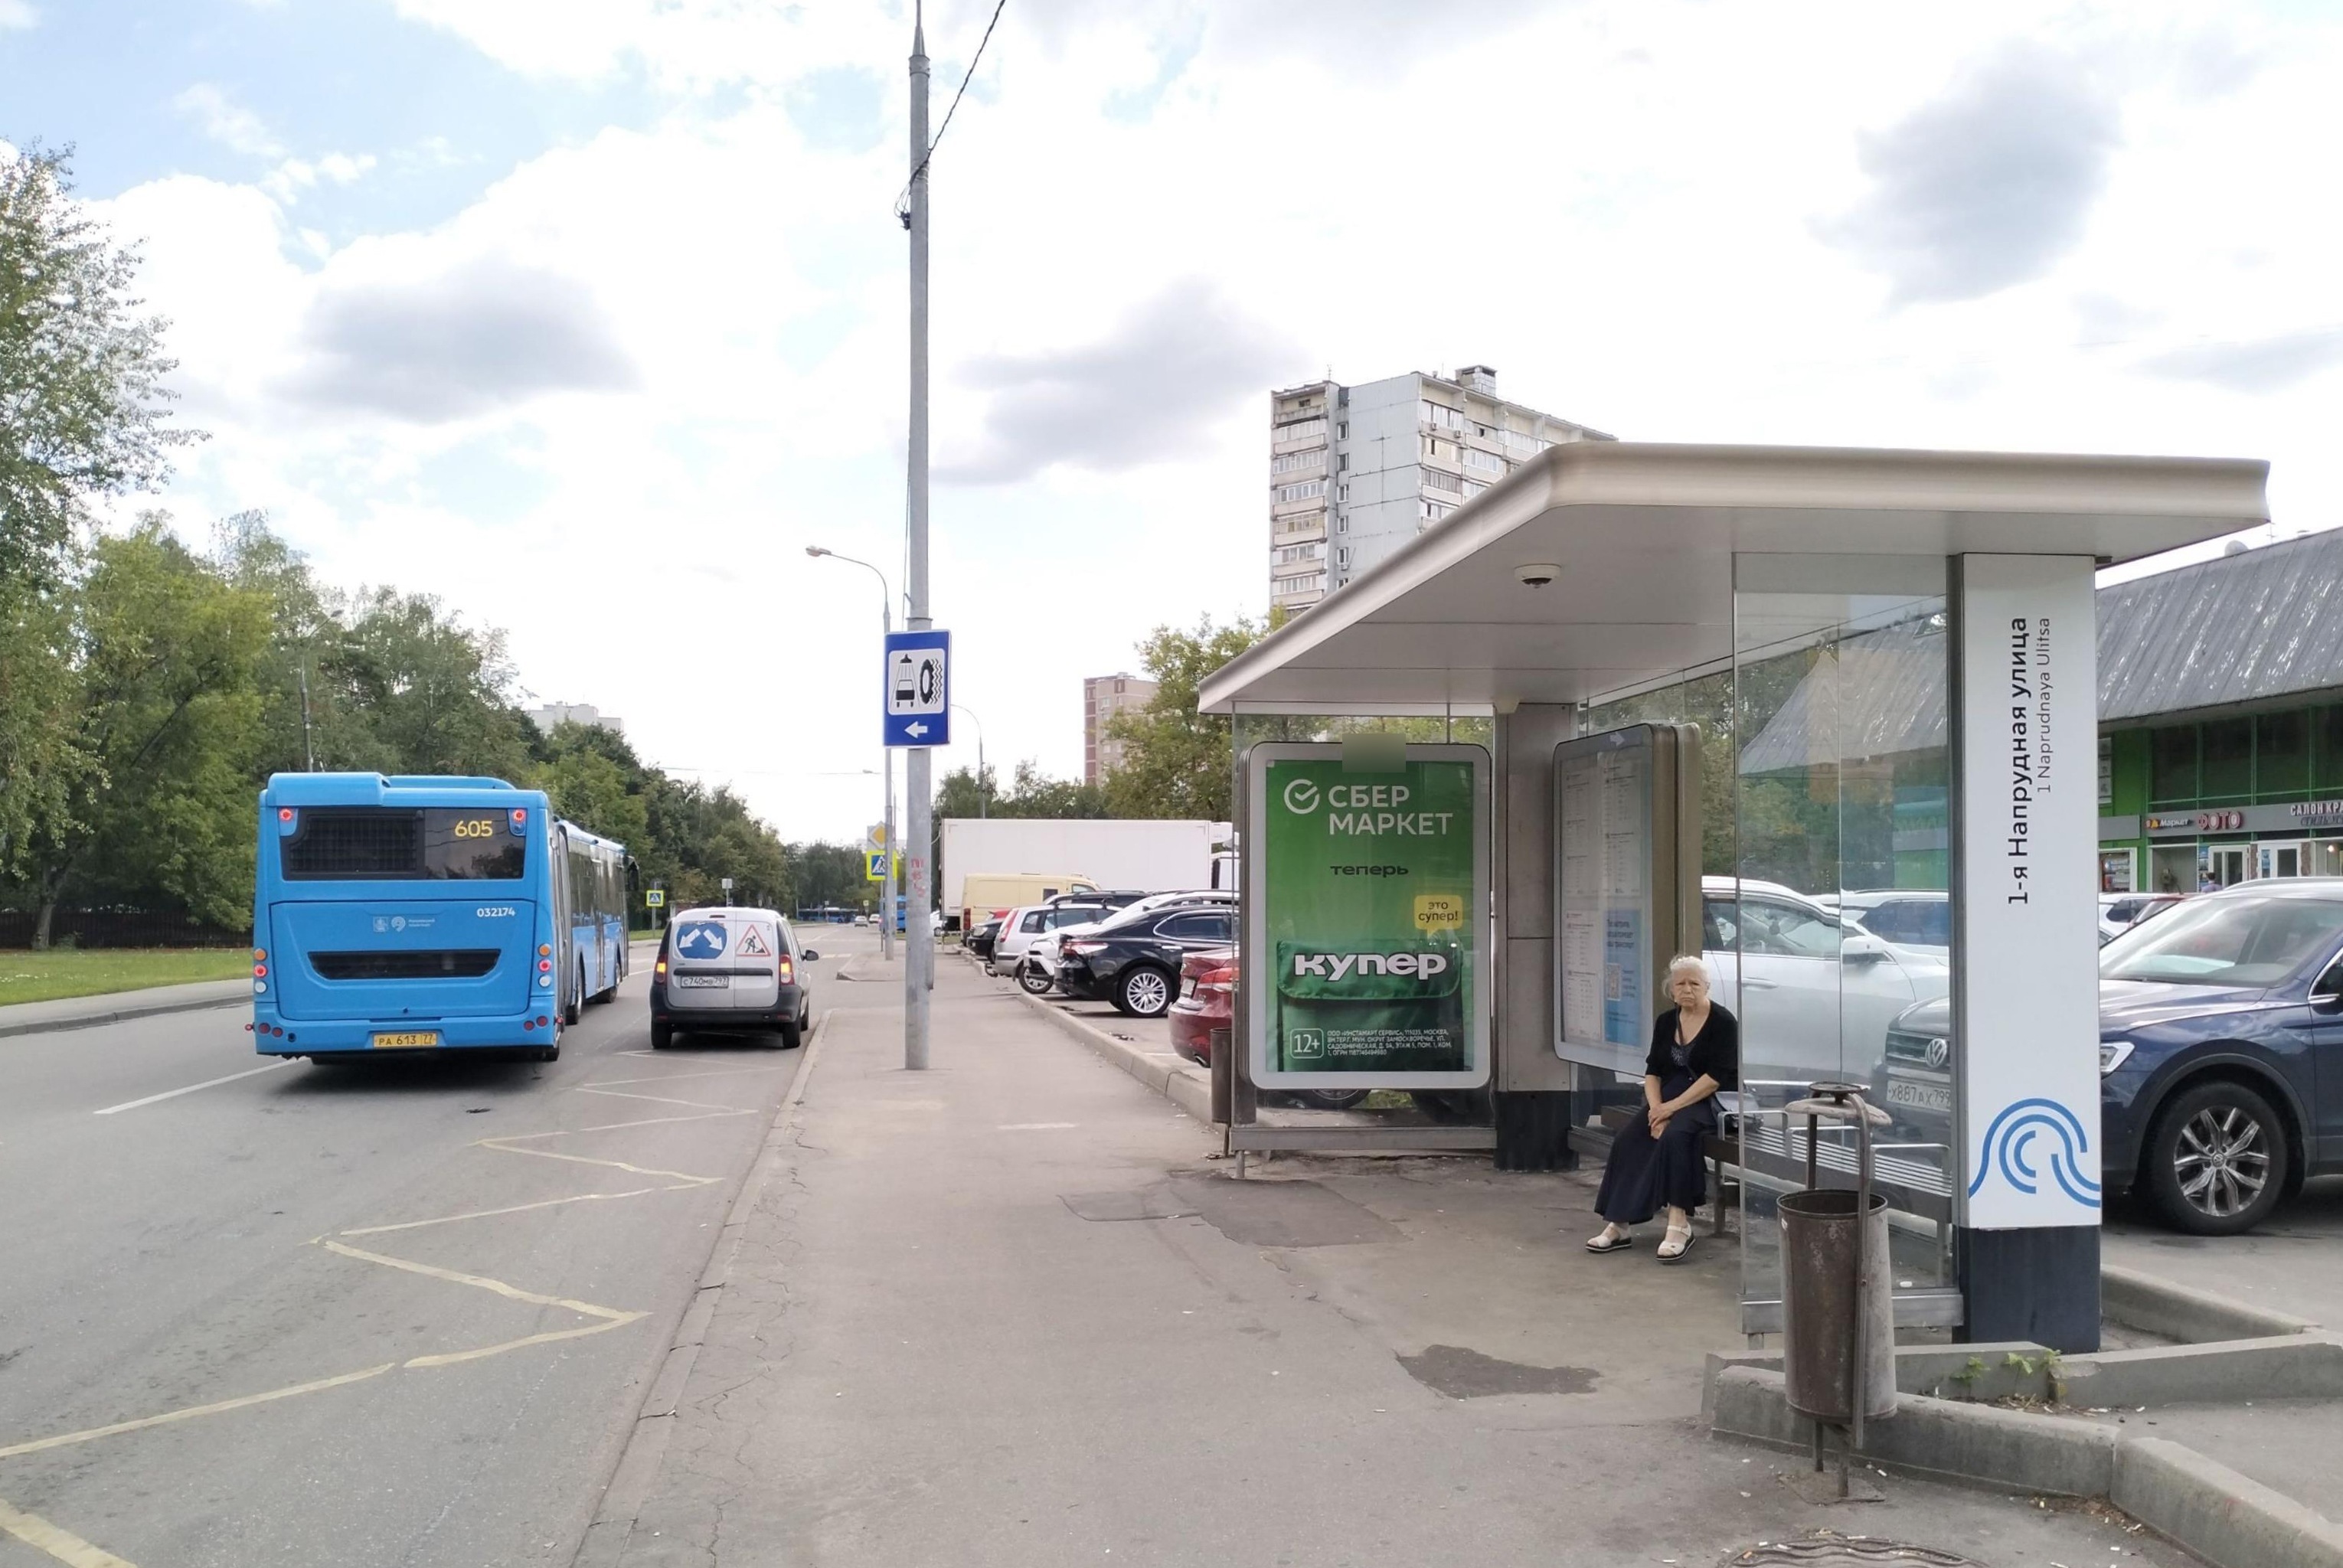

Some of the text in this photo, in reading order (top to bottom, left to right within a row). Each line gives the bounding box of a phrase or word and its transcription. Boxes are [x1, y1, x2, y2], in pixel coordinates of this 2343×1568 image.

[2036, 617, 2054, 793] 1 Naprudnaya Ulitsa
[2008, 617, 2032, 904] 1-я Напрудная улица
[1328, 786, 1410, 808] СБЕР
[2290, 803, 2323, 816] САЛОН
[455, 820, 493, 837] 605
[1328, 812, 1453, 835] МАРКЕТ
[2198, 811, 2241, 830] ФОТО
[1330, 864, 1409, 877] теперь
[476, 907, 516, 917] 032174
[1428, 901, 1449, 910] это
[1418, 910, 1458, 923] супер!
[1294, 952, 1448, 982] купер
[1293, 1034, 1321, 1053] 12+
